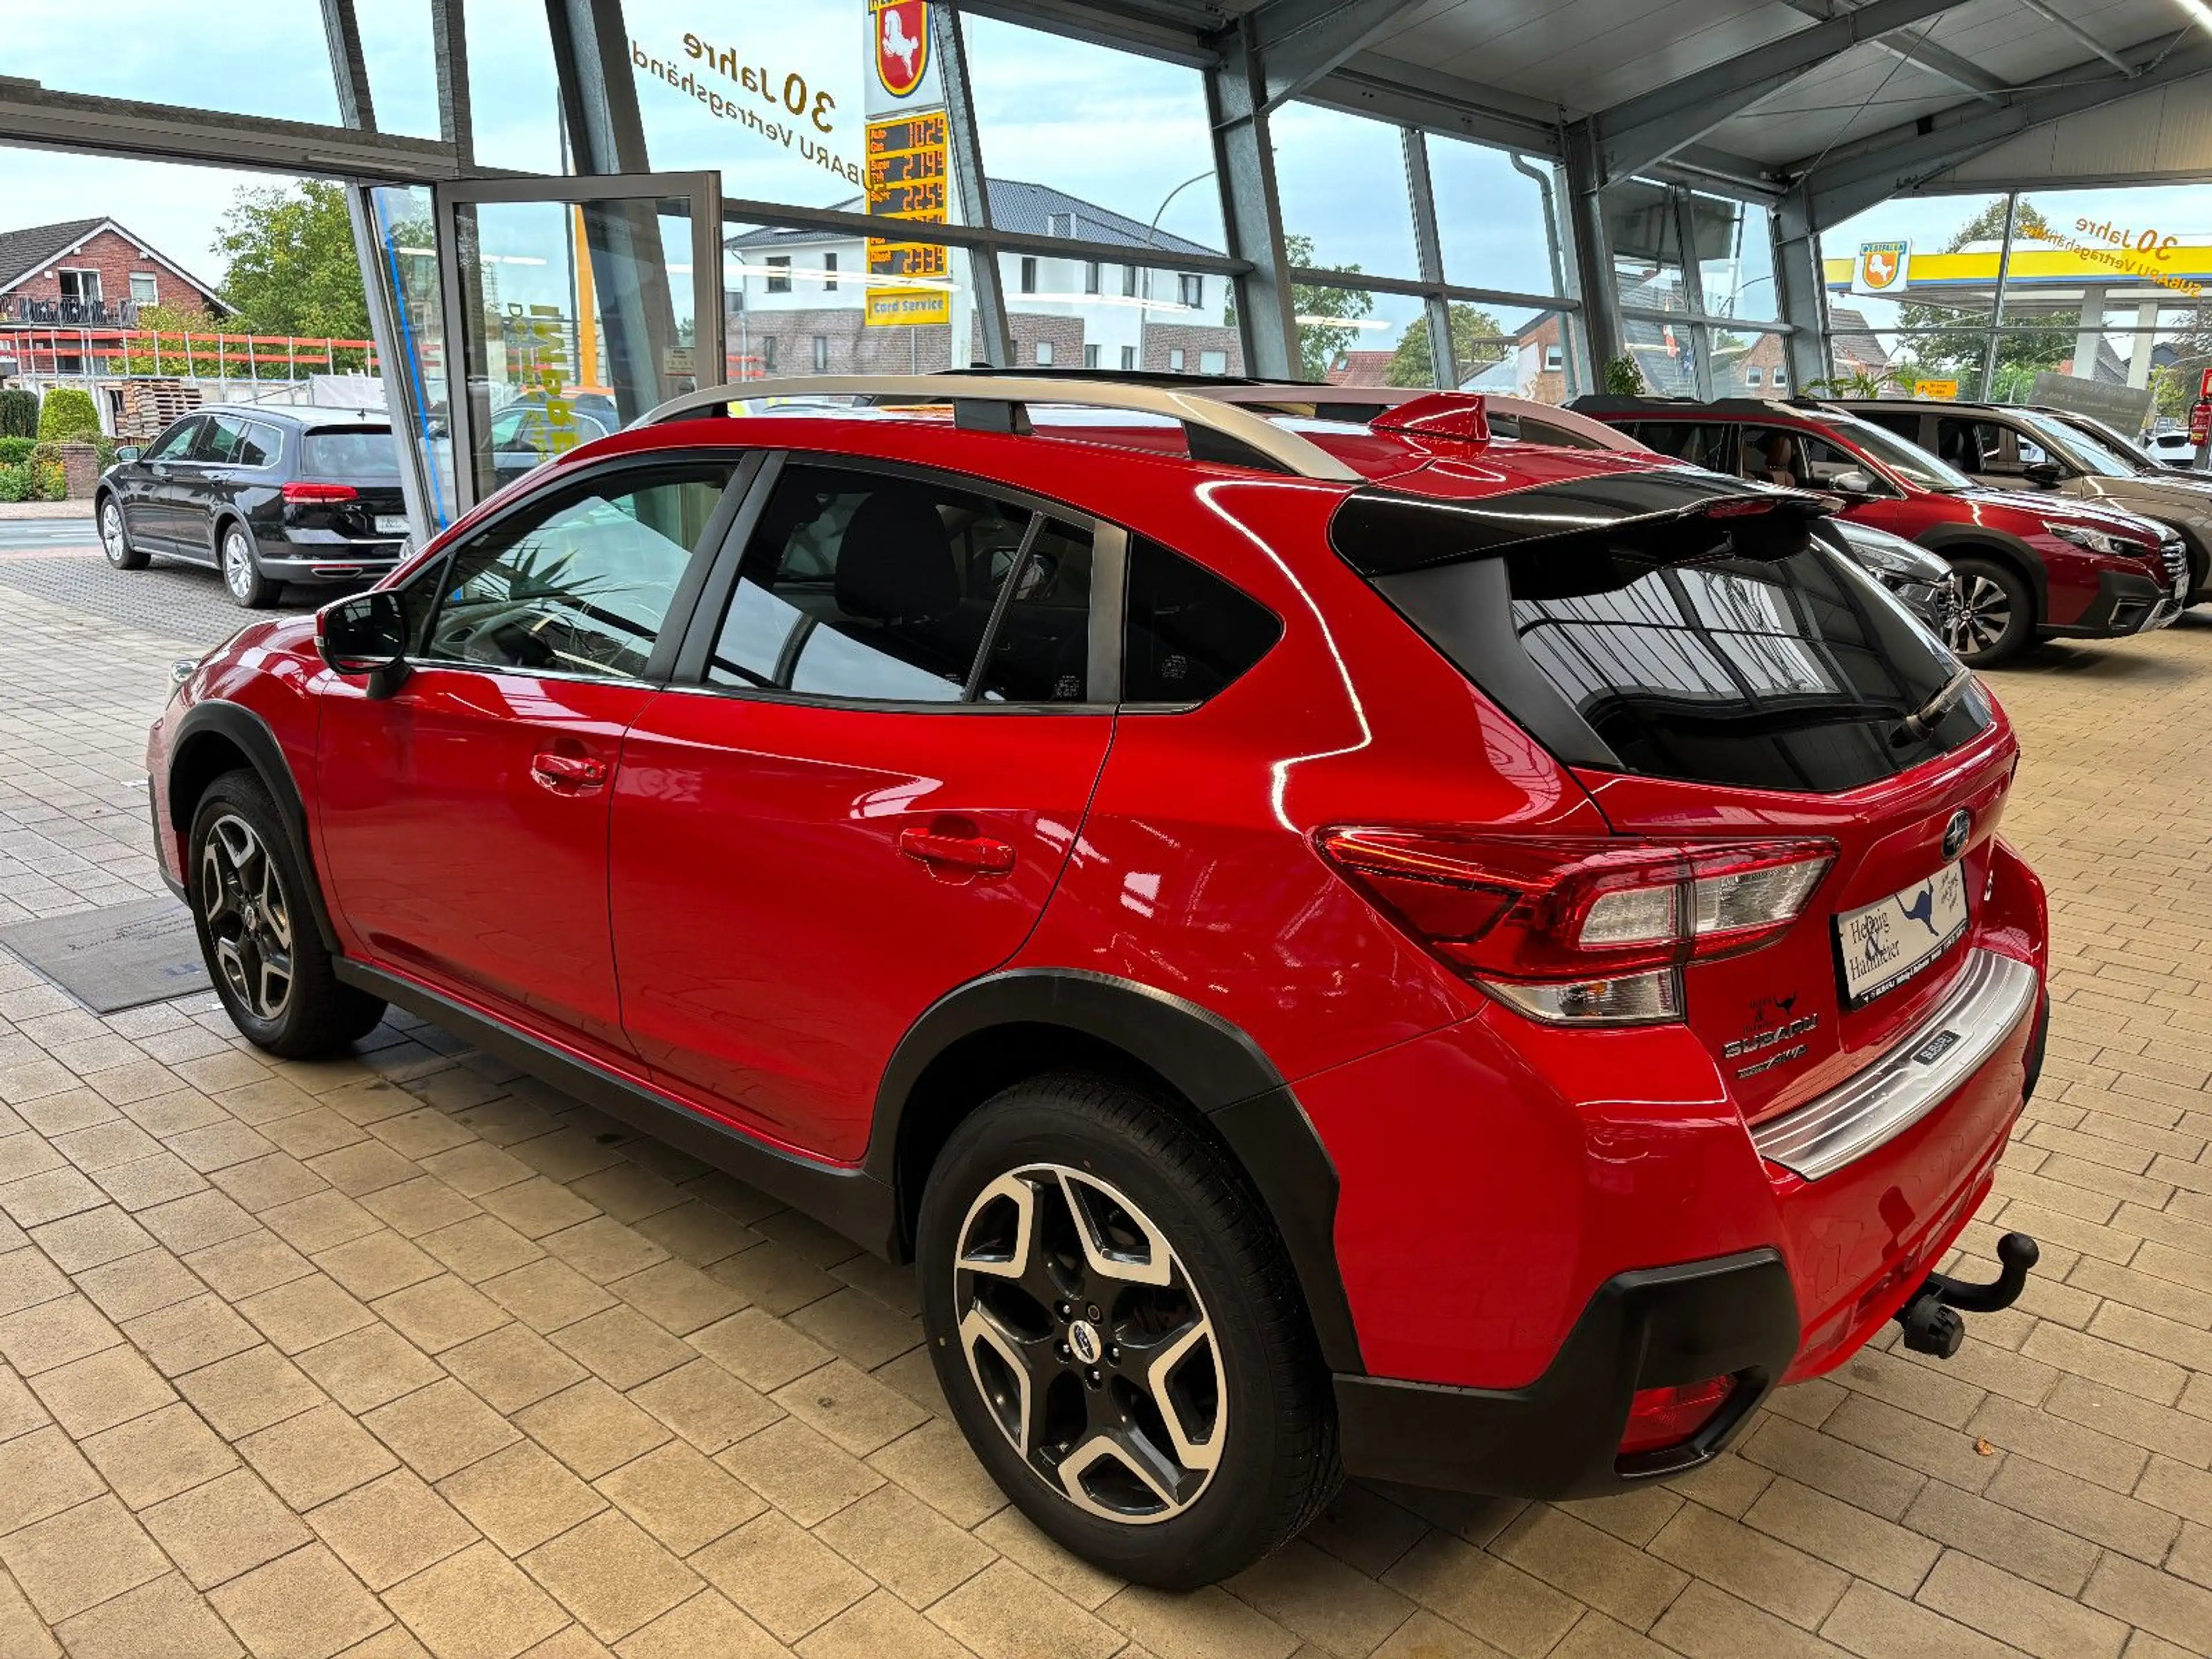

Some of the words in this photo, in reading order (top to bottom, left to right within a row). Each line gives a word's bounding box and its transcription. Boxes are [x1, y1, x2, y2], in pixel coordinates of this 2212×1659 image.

[874, 300, 899, 313] Card
[902, 298, 944, 312] Service
[1723, 1013, 1819, 1058] SUBARU
[1919, 1034, 1953, 1060] SUBARU
